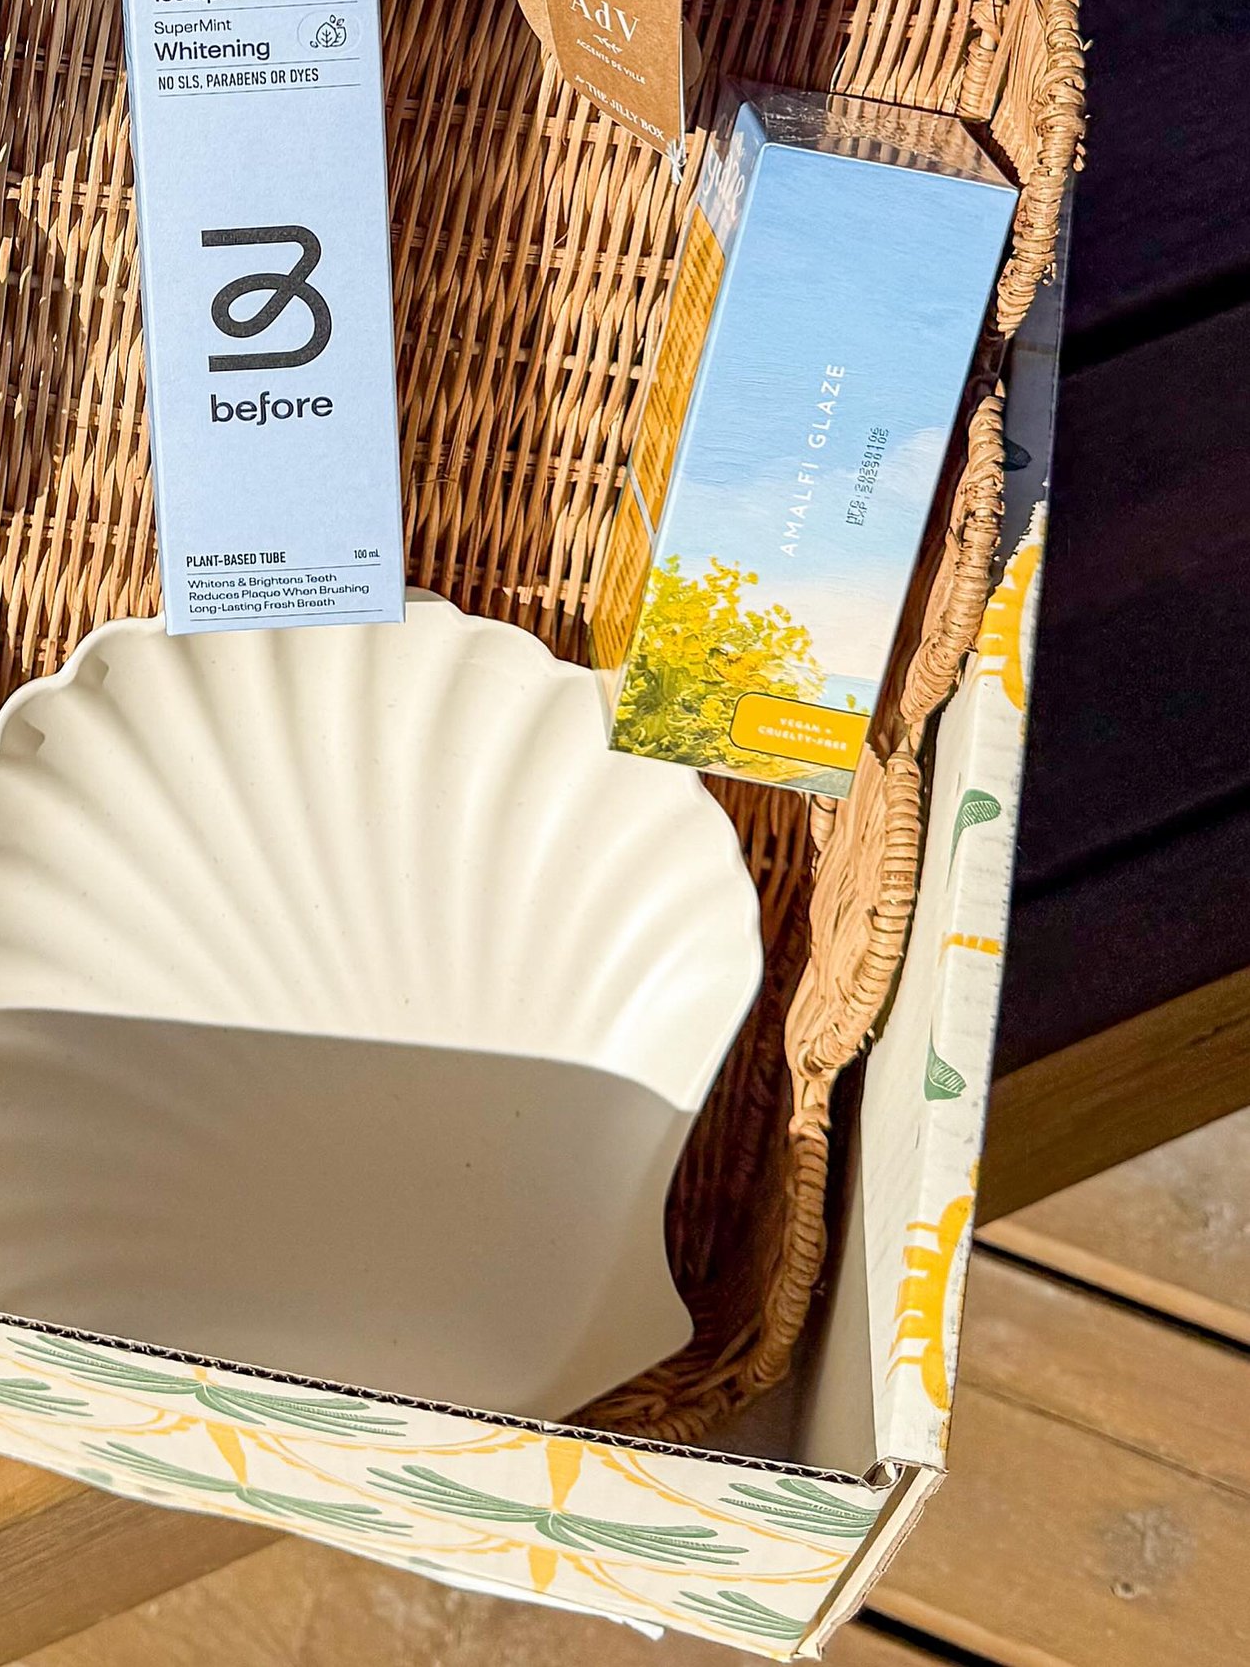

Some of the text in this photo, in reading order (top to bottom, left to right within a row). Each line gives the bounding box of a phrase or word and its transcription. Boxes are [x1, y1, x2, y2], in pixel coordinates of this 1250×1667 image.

[153, 18, 232, 37] SuperMint
[154, 38, 271, 62] Whitening
[576, 38, 646, 85] ACCENTS DE VILLE
[157, 67, 320, 91] NO SLS, PARABENS OR DYES
[585, 80, 609, 104] THE
[609, 97, 639, 125] JILLY
[639, 117, 666, 142] BOX
[210, 390, 334, 426] before
[779, 364, 846, 558] AMALFI GLAZE
[186, 551, 287, 568] PLANT-BASED TUBE
[353, 548, 368, 560] 100
[237, 577, 247, 588] &
[282, 586, 318, 597] When
[319, 583, 370, 596] Brushing
[189, 601, 262, 615] Long-Lasting
[779, 717, 822, 734] VEGAN
[757, 725, 848, 752] CRUELTY-FREE
